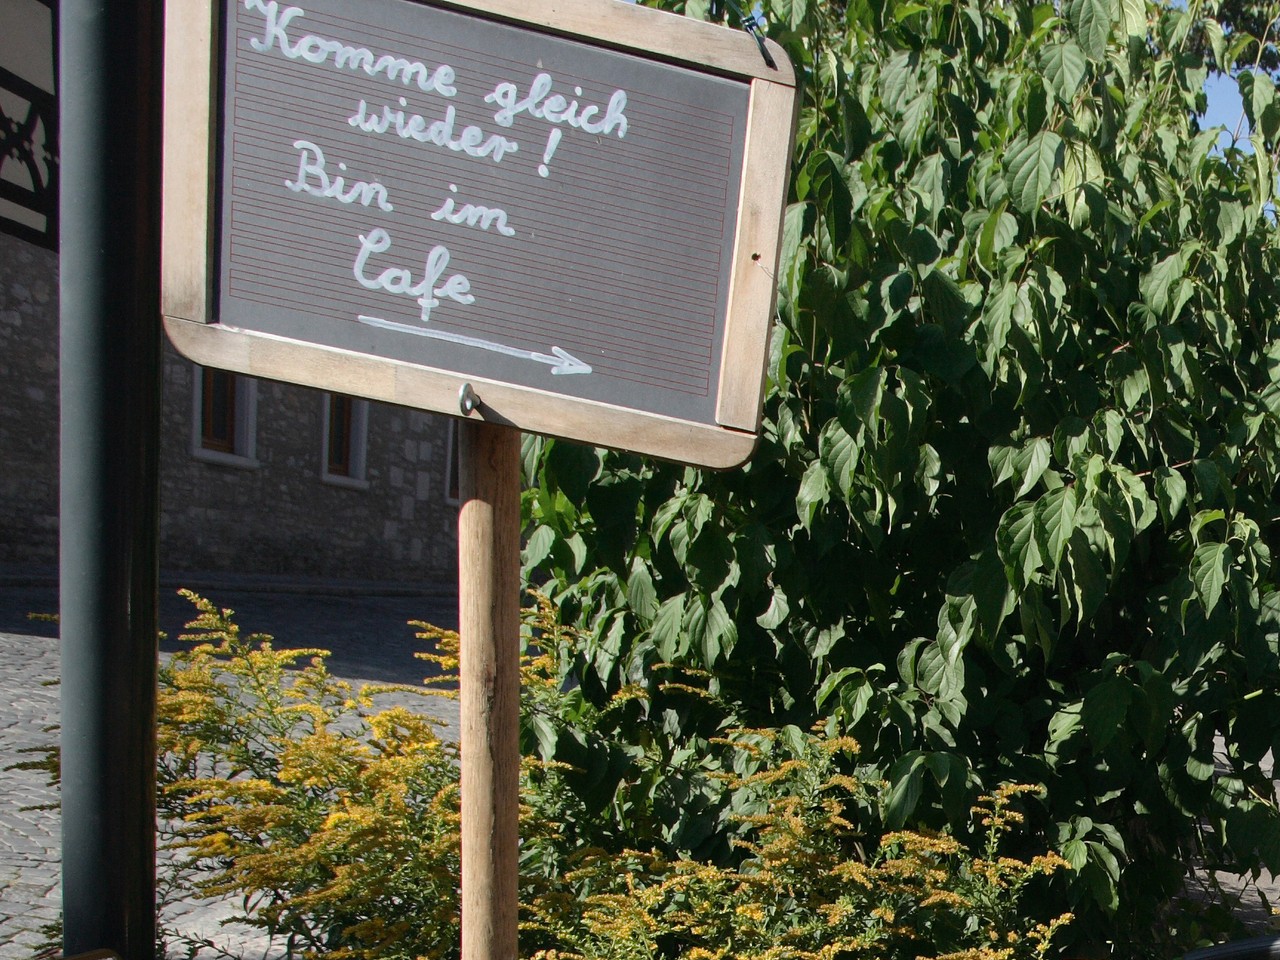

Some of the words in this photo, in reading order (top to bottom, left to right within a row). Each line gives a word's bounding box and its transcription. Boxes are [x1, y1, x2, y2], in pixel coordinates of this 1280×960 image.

[244, 0, 457, 97] Komme
[484, 72, 630, 139] gleich
[284, 140, 394, 212] Bin
[431, 183, 516, 237] im
[353, 228, 475, 321] Cafe
